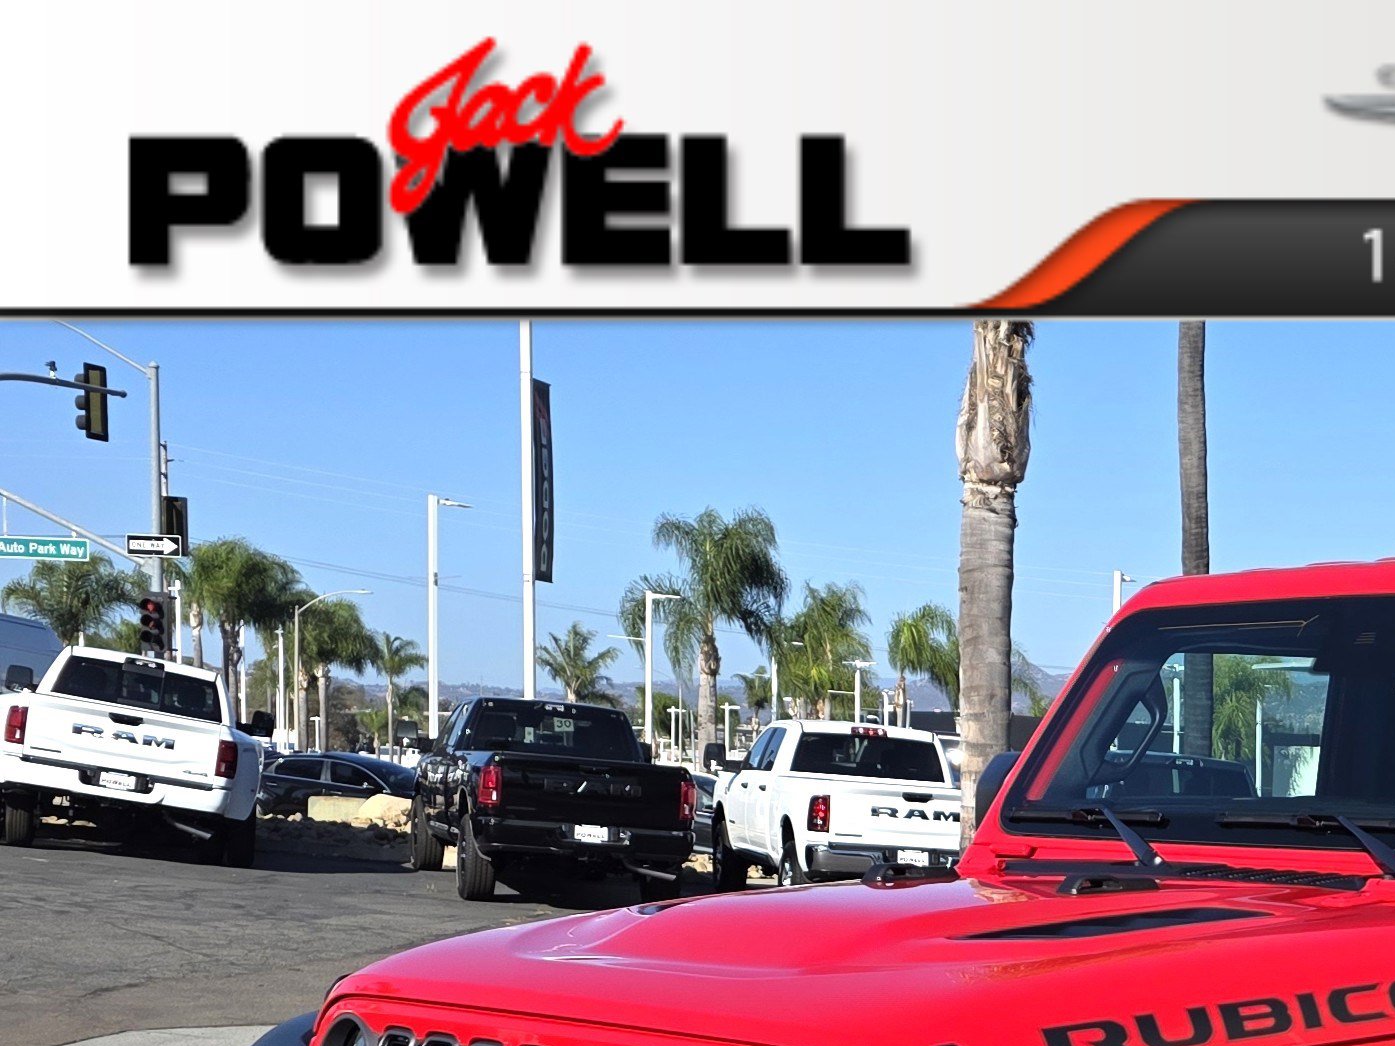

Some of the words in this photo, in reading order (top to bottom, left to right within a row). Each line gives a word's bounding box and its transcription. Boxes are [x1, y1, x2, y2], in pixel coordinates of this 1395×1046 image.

[0, 541, 24, 553] Auto
[29, 541, 57, 555] Park
[60, 543, 85, 558] Way
[131, 541, 147, 549] ONE
[150, 542, 165, 550] WAY
[556, 719, 572, 729] 30
[71, 722, 176, 751] RAM
[871, 805, 960, 823] RAM
